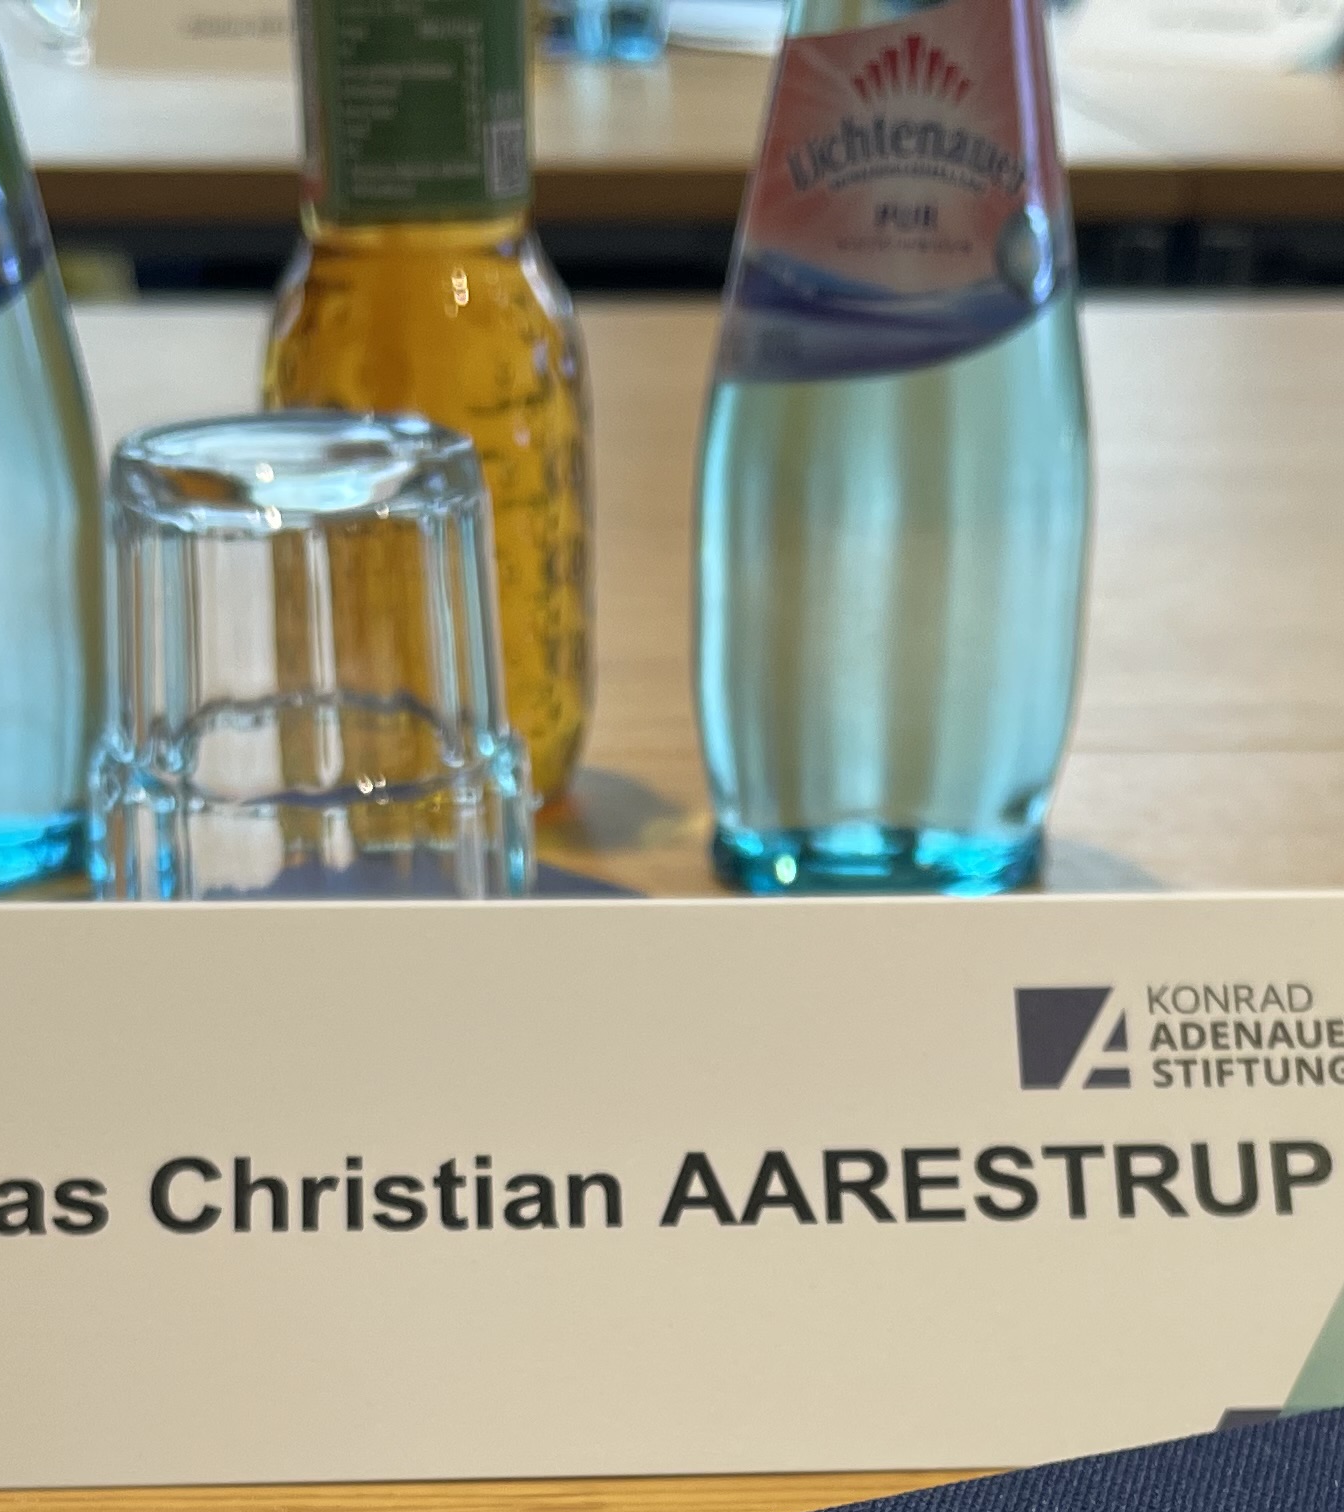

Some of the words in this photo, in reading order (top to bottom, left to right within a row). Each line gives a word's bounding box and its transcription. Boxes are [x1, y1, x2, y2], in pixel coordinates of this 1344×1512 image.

[1147, 983, 1314, 1015] KONRAD
[149, 1154, 624, 1236] Christian
[658, 1140, 1334, 1228] AARESTRUP
